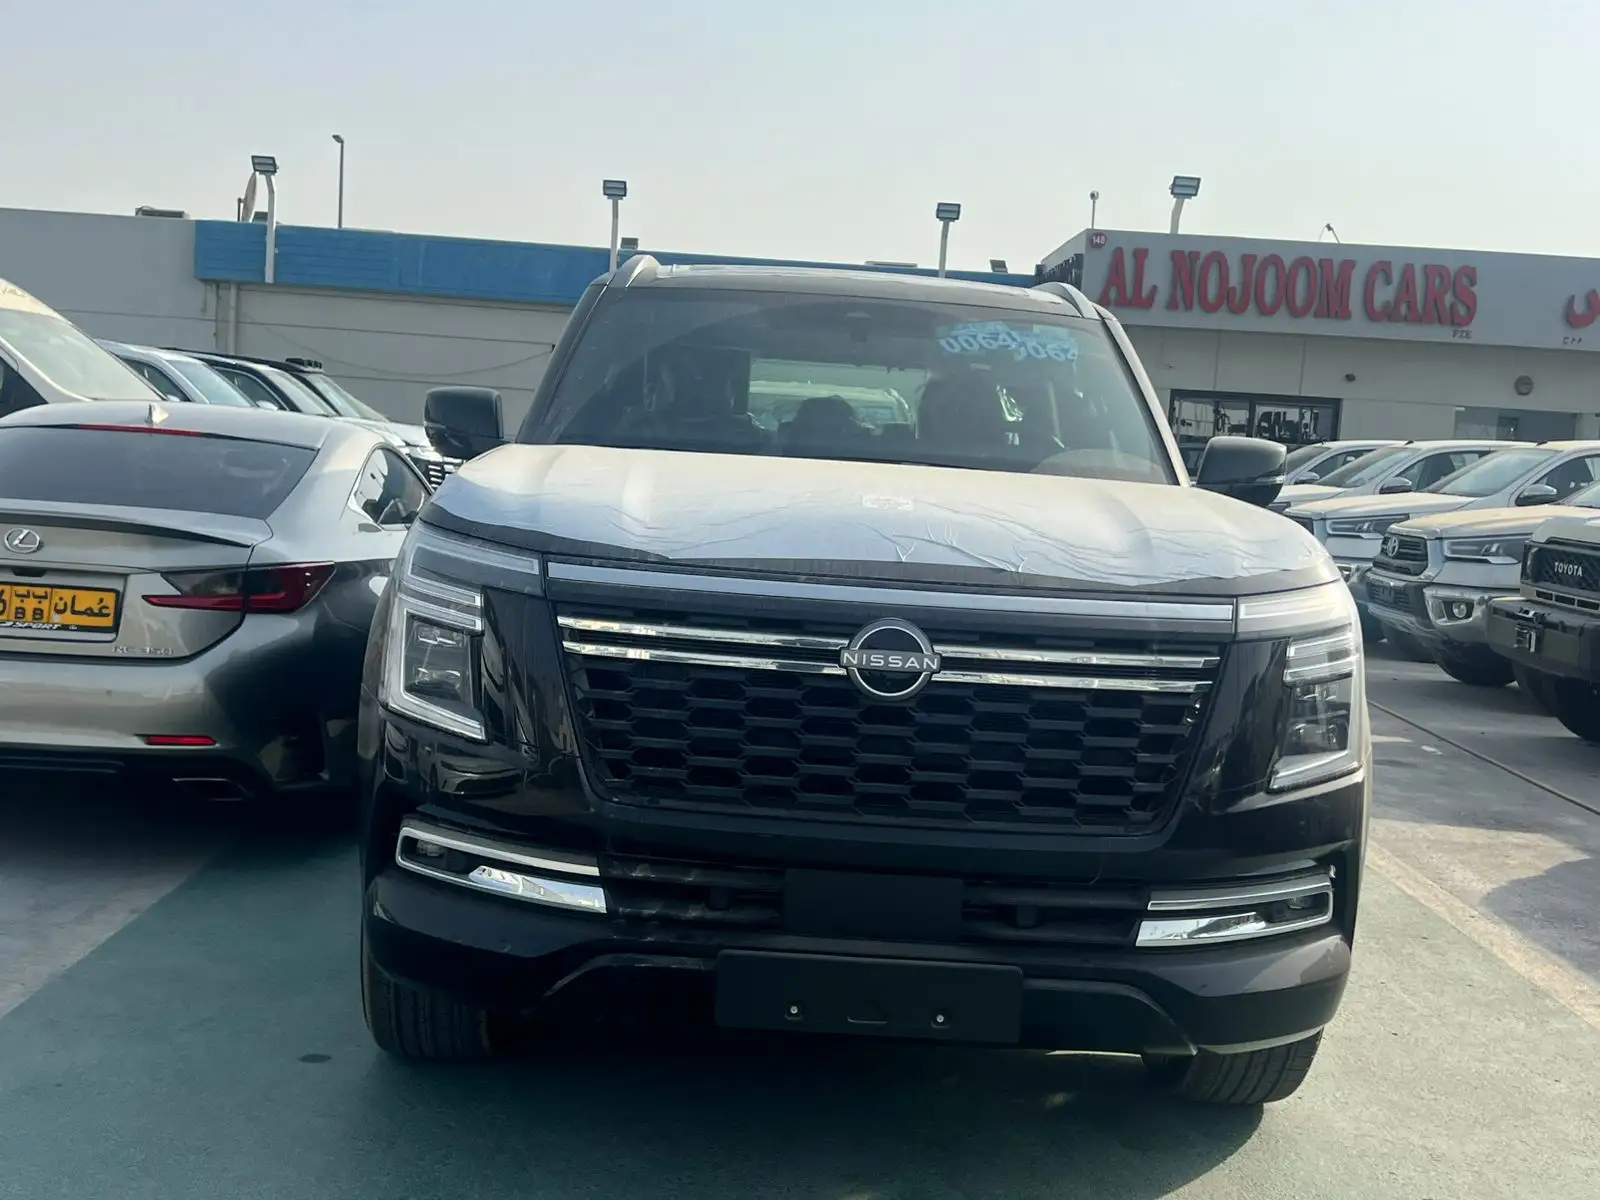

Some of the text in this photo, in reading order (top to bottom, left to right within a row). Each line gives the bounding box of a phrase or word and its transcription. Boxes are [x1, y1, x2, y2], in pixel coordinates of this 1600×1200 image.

[1097, 246, 1477, 328] AL NOJOOM CARS
[1554, 561, 1583, 577] TOYOTA
[843, 652, 938, 670] NISSAN
